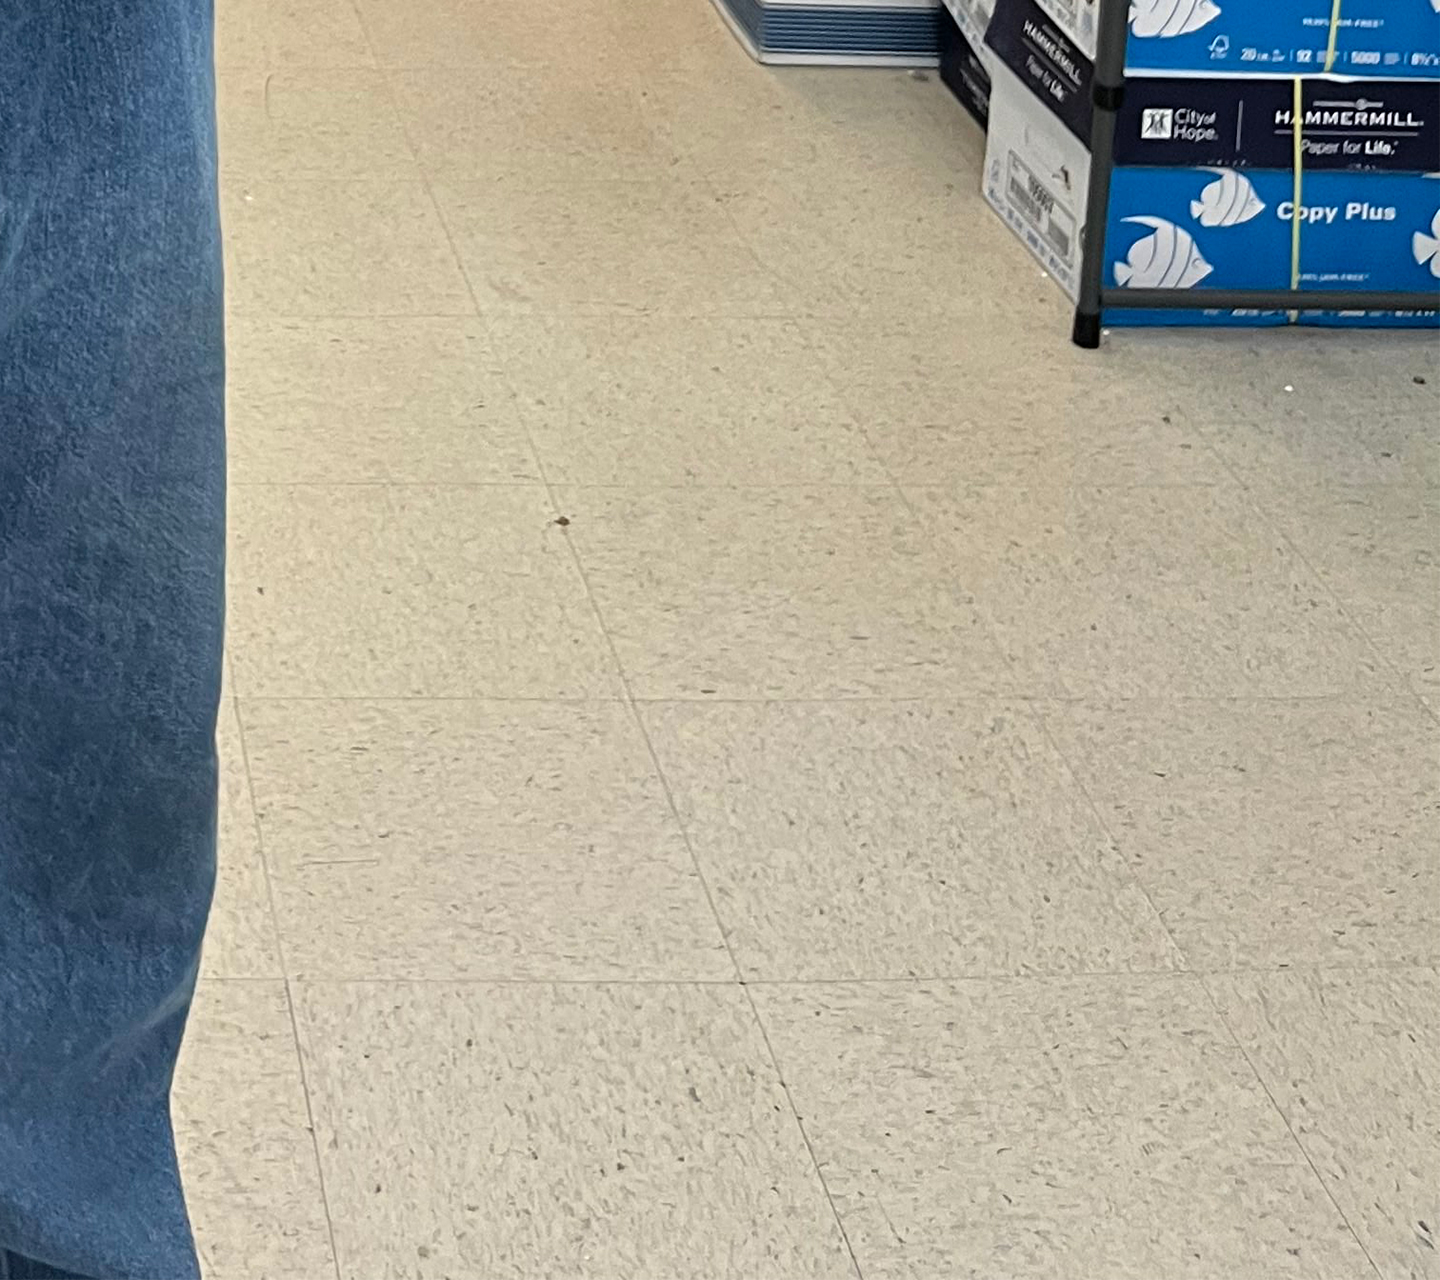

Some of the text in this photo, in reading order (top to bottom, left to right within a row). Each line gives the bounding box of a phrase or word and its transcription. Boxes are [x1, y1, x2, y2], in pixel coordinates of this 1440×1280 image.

[1174, 108, 1206, 128] City
[1342, 140, 1363, 155] for
[1276, 201, 1397, 224] Copy Plus
